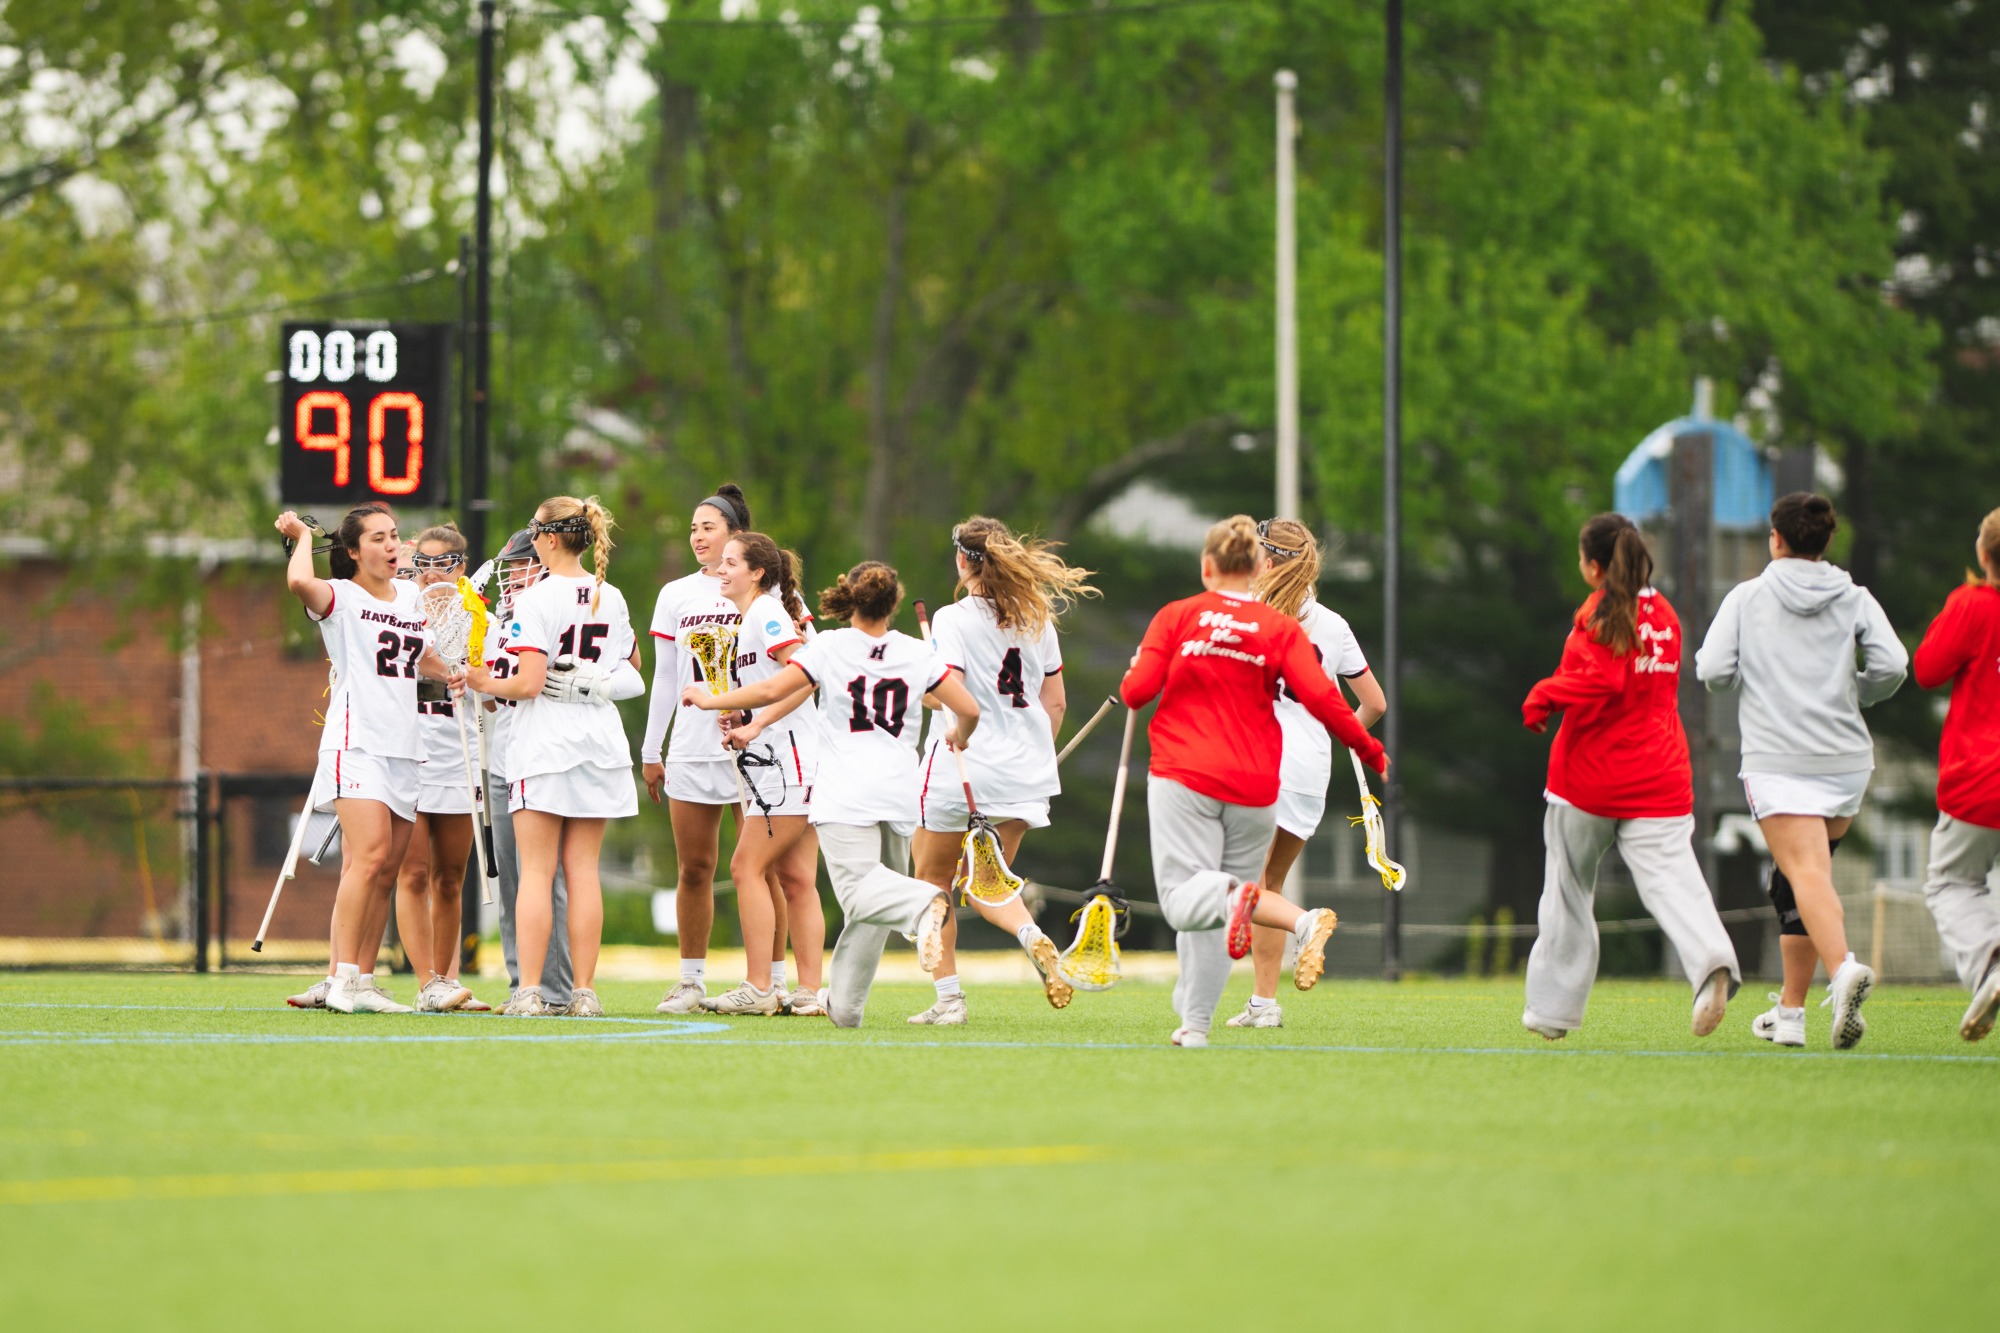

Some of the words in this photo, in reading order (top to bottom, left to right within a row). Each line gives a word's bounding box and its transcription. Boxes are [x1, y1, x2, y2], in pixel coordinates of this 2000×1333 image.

[296, 391, 424, 495] 90
[576, 586, 592, 606] H
[679, 613, 743, 629] HAVERFO
[376, 629, 425, 679] 27
[559, 623, 610, 663] 15
[867, 643, 889, 662] H
[996, 647, 1030, 709] 4
[847, 675, 910, 739] 10
[728, 991, 755, 1007] N
